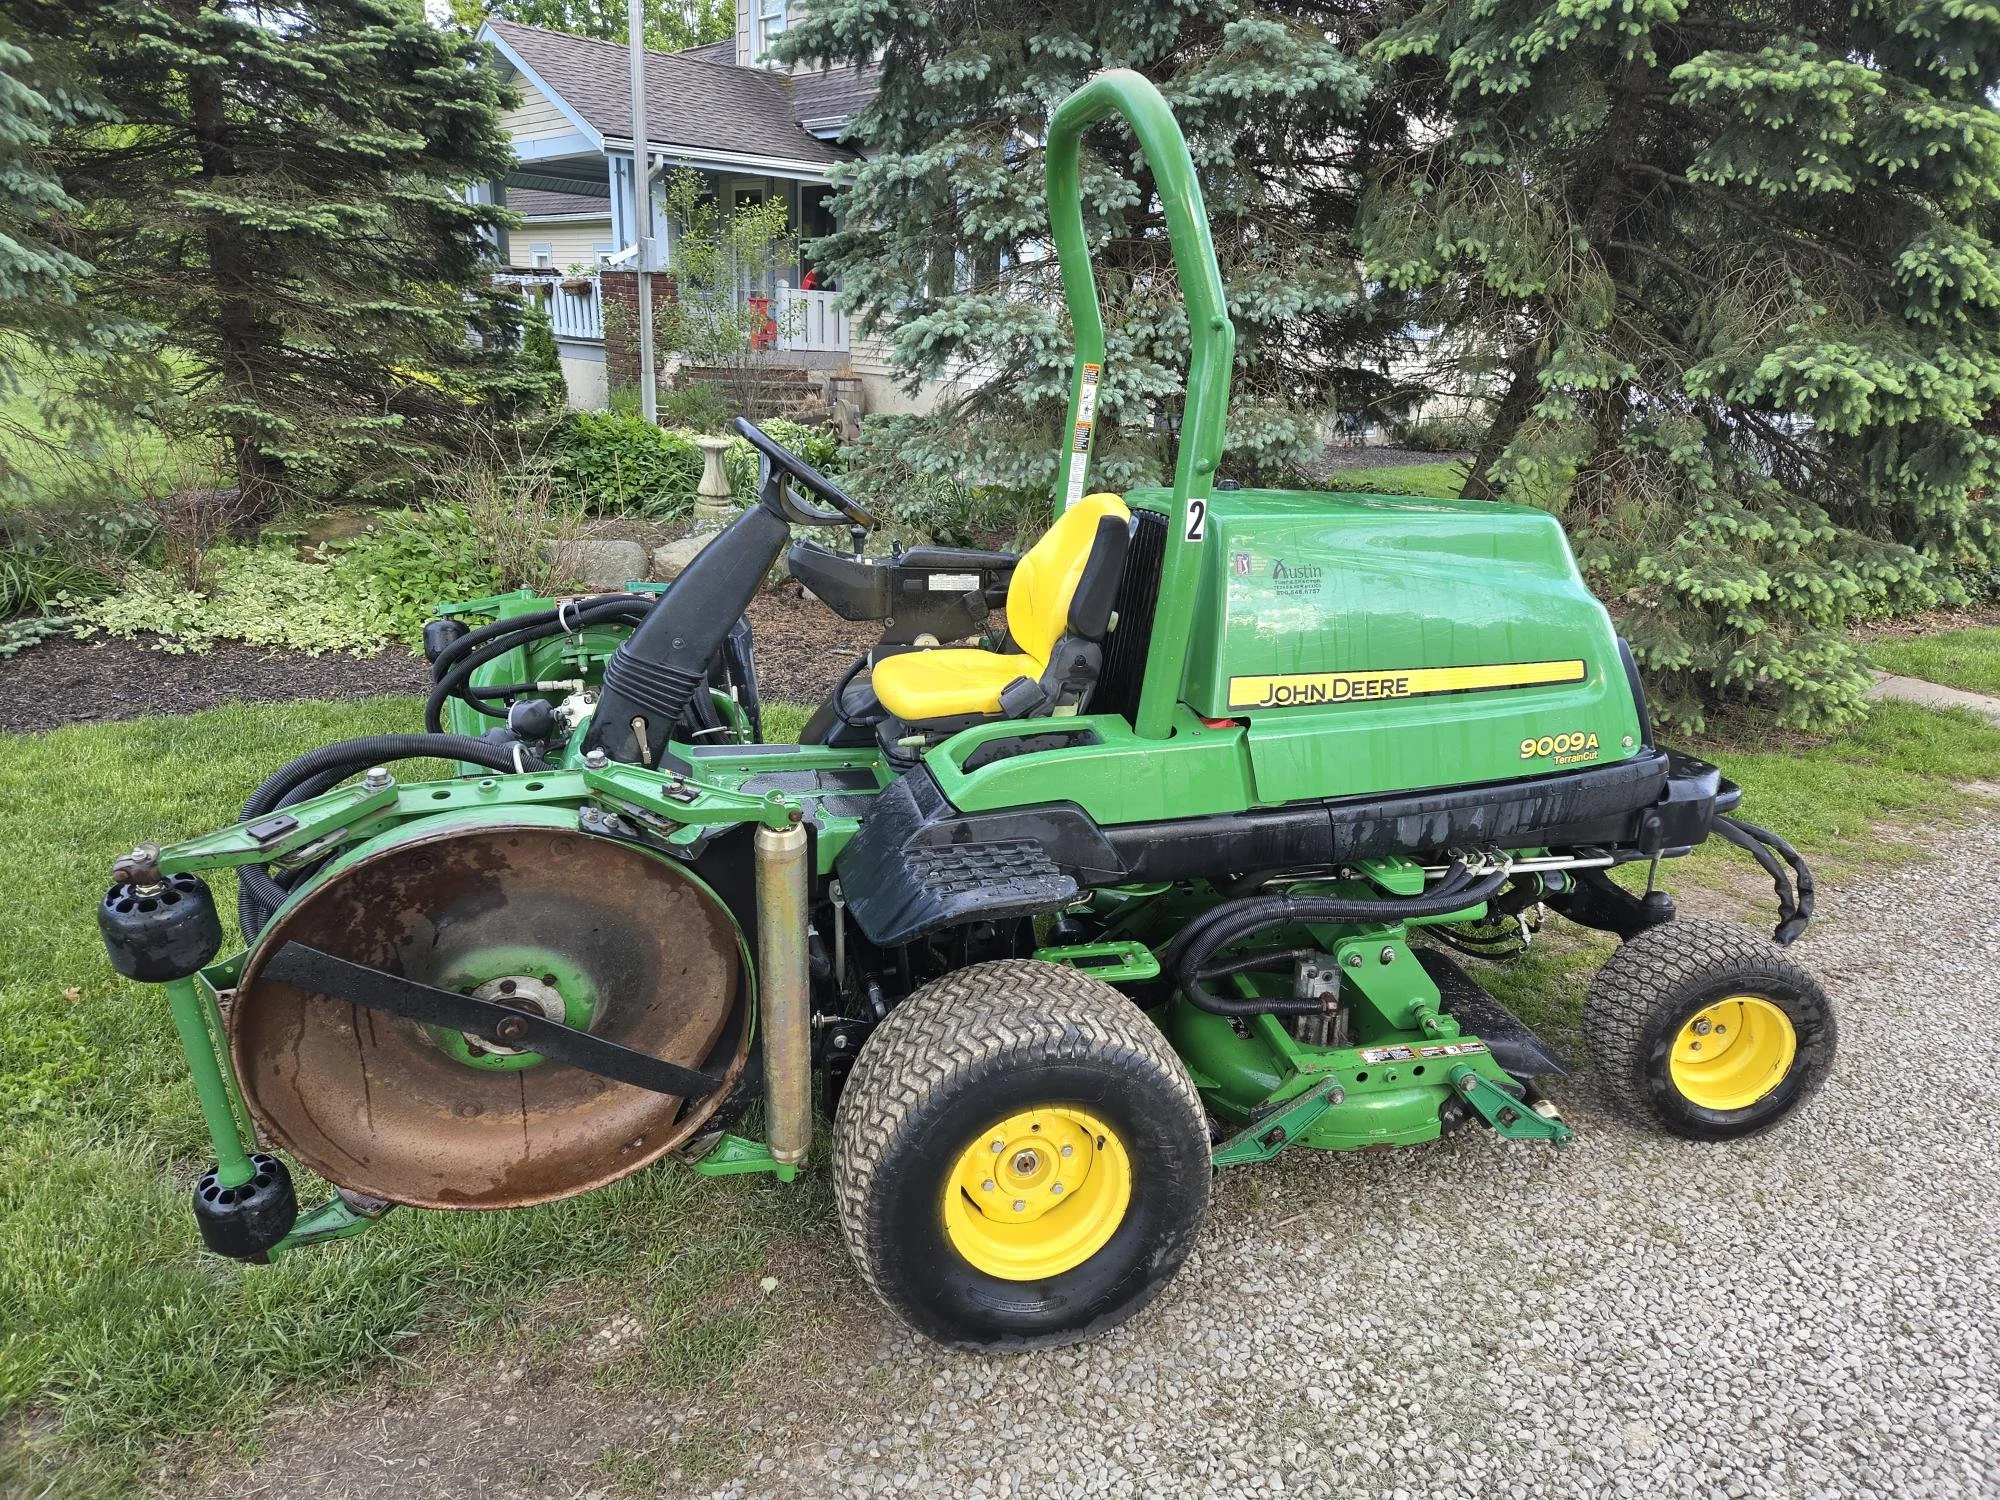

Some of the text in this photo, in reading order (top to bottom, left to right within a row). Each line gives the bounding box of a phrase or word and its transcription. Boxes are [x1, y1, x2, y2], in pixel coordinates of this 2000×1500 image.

[1187, 500, 1205, 540] 2
[1272, 558, 1322, 579] Austin
[1260, 677, 1409, 704] JOHN DEERE
[1520, 731, 1599, 759] 9009A
